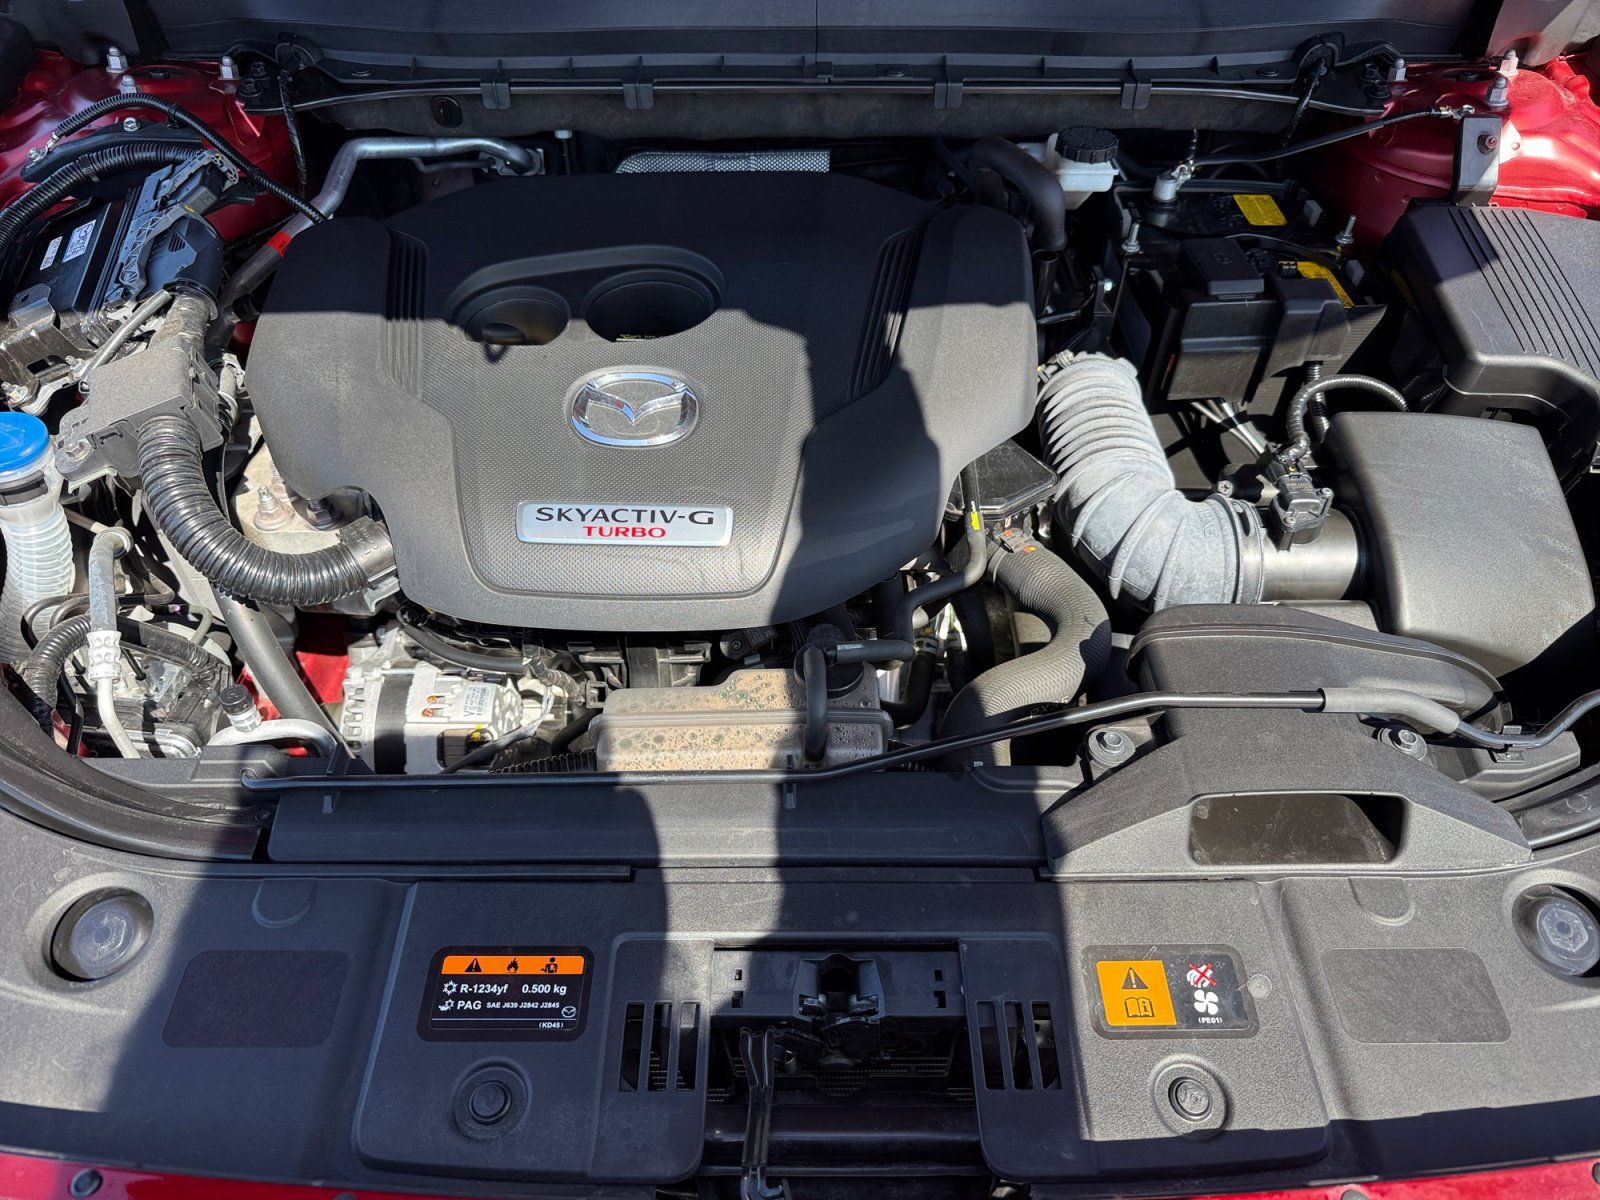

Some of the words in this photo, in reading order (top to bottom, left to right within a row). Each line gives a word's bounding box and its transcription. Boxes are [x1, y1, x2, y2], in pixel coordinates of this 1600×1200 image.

[535, 506, 715, 526] SKYACTIV-G
[583, 526, 666, 538] TURBO
[460, 984, 509, 996] R-1234yf
[522, 984, 550, 994] 0.500
[553, 984, 567, 996] kg
[457, 1001, 482, 1010] PAG
